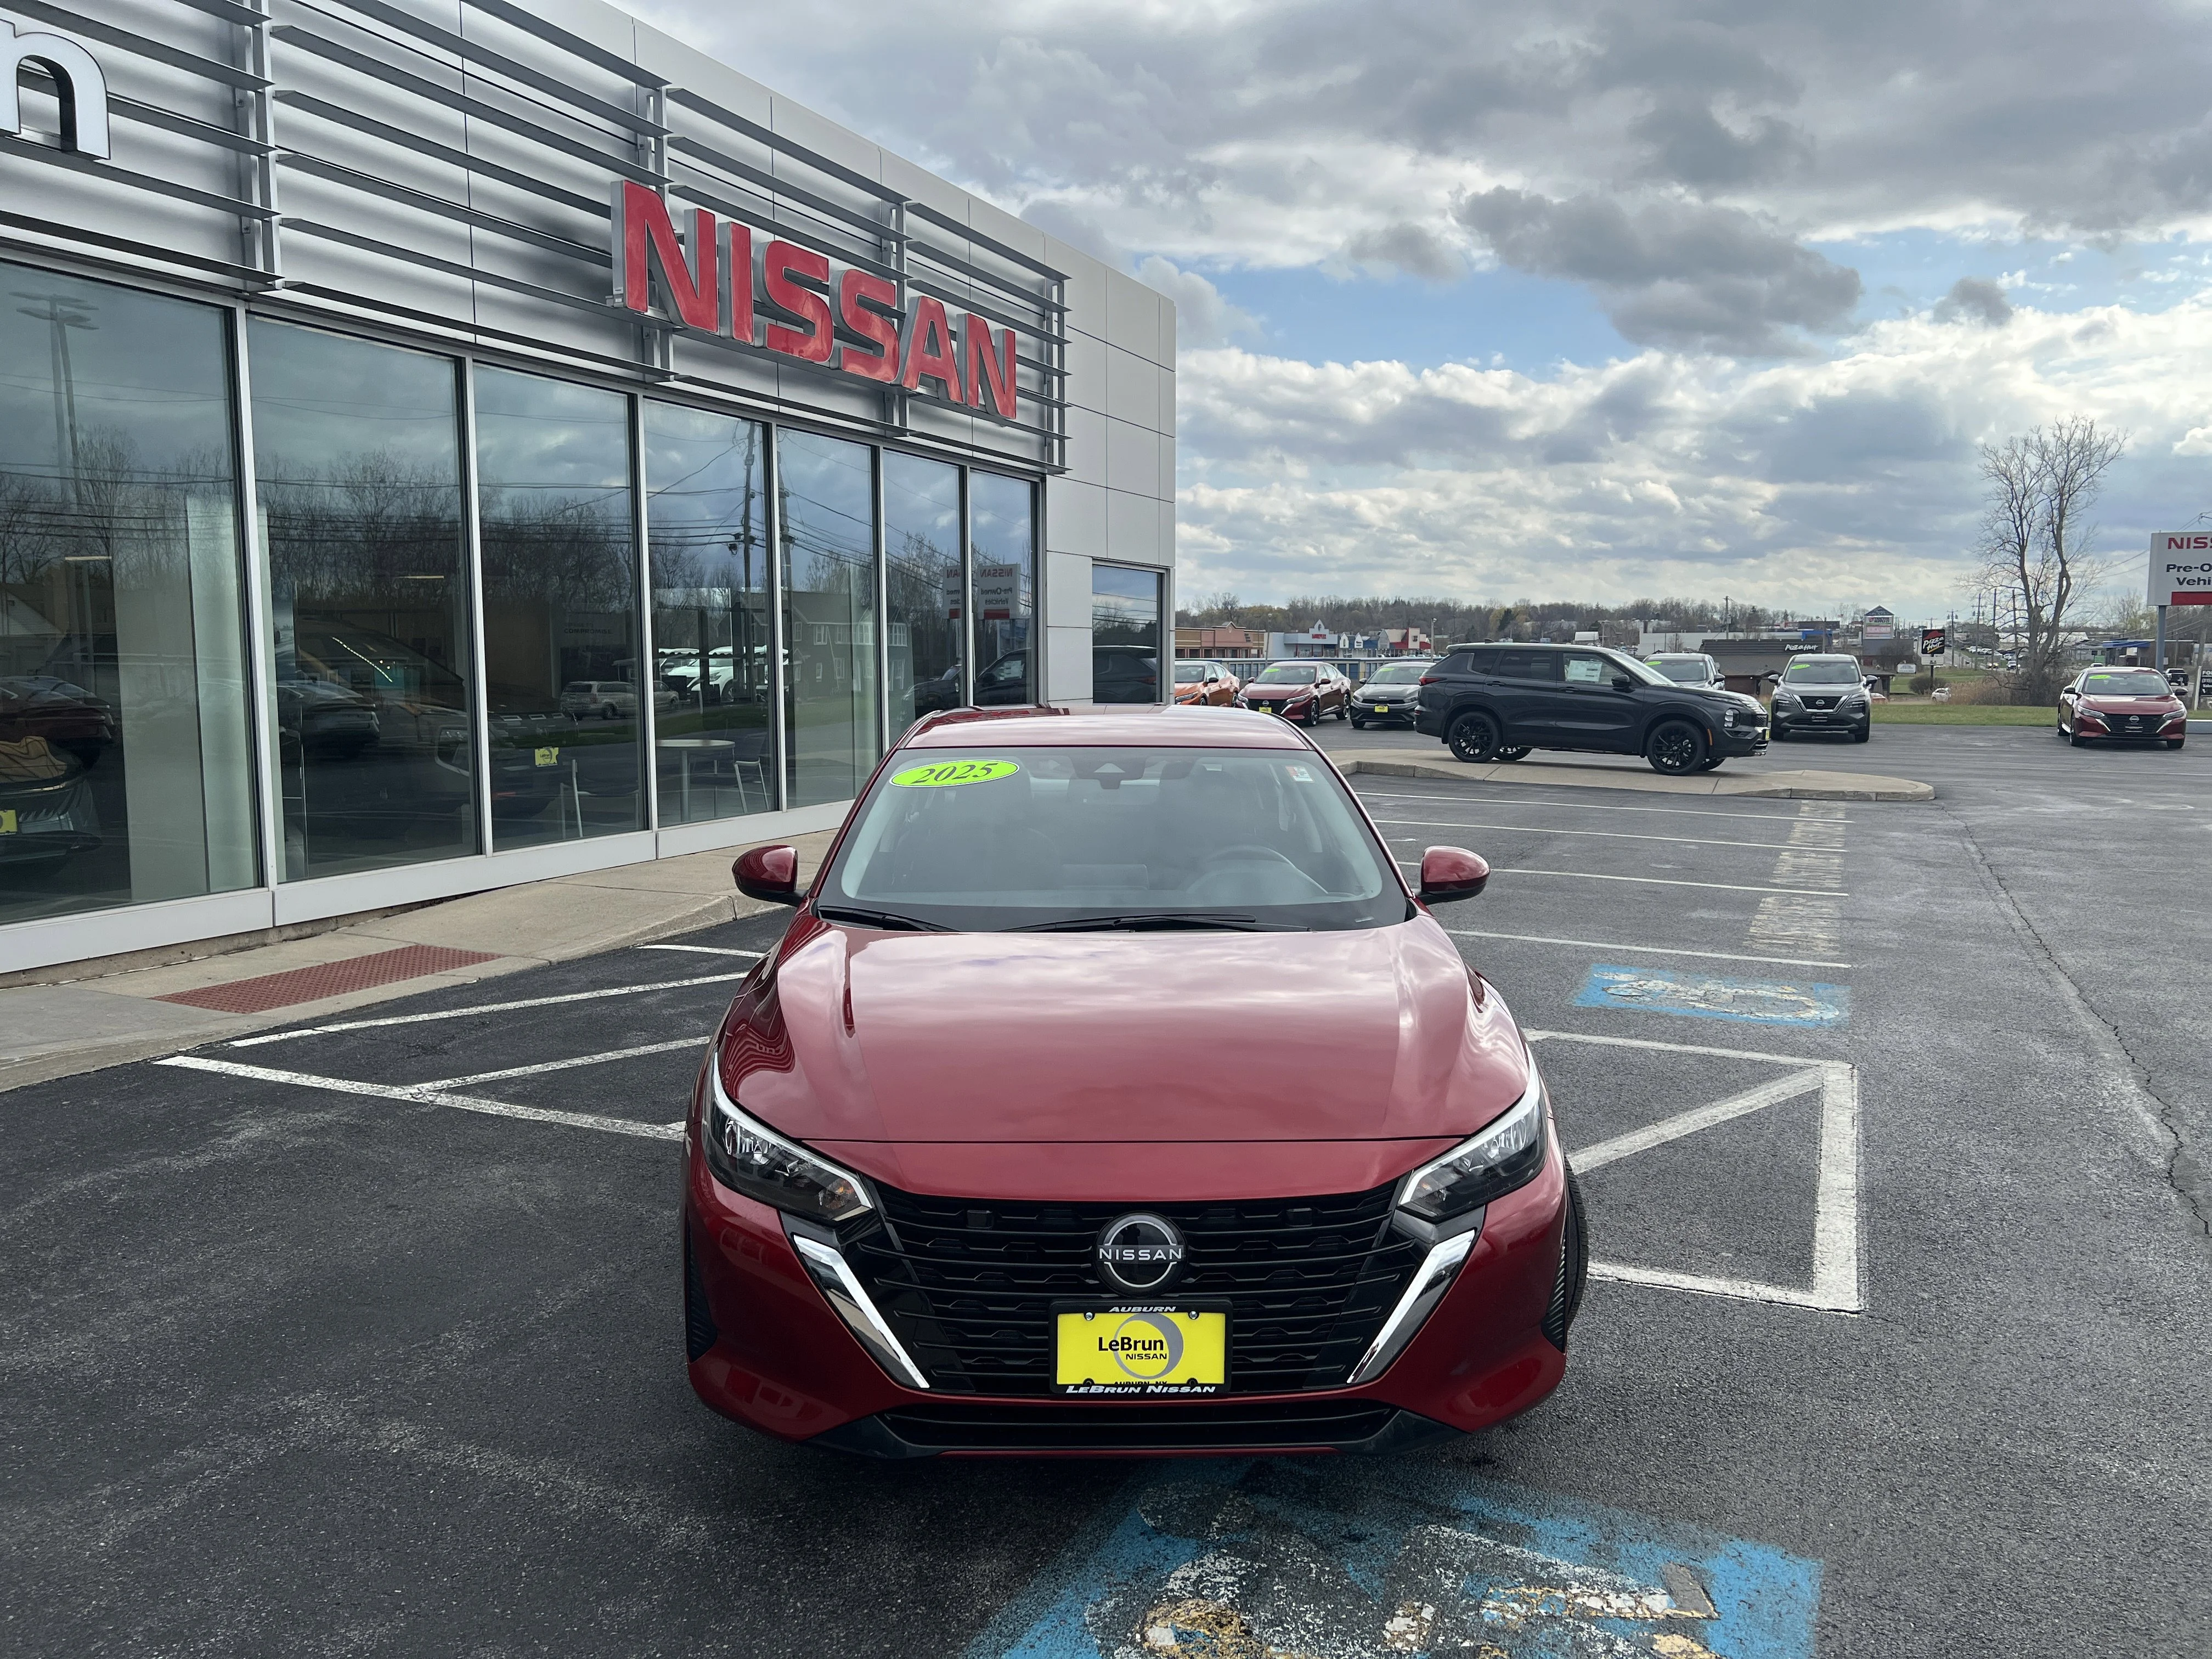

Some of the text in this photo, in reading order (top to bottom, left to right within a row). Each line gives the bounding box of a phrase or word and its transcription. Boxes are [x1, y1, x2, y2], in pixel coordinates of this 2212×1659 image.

[611, 179, 1017, 420] NISSAN
[2168, 537, 2212, 549] NIS
[1922, 637, 1944, 649] Pizza
[1927, 641, 1943, 651] Hut
[910, 763, 998, 784] 2025
[1099, 1248, 1182, 1260] NISSAN
[1098, 1336, 1164, 1351] LeBrun
